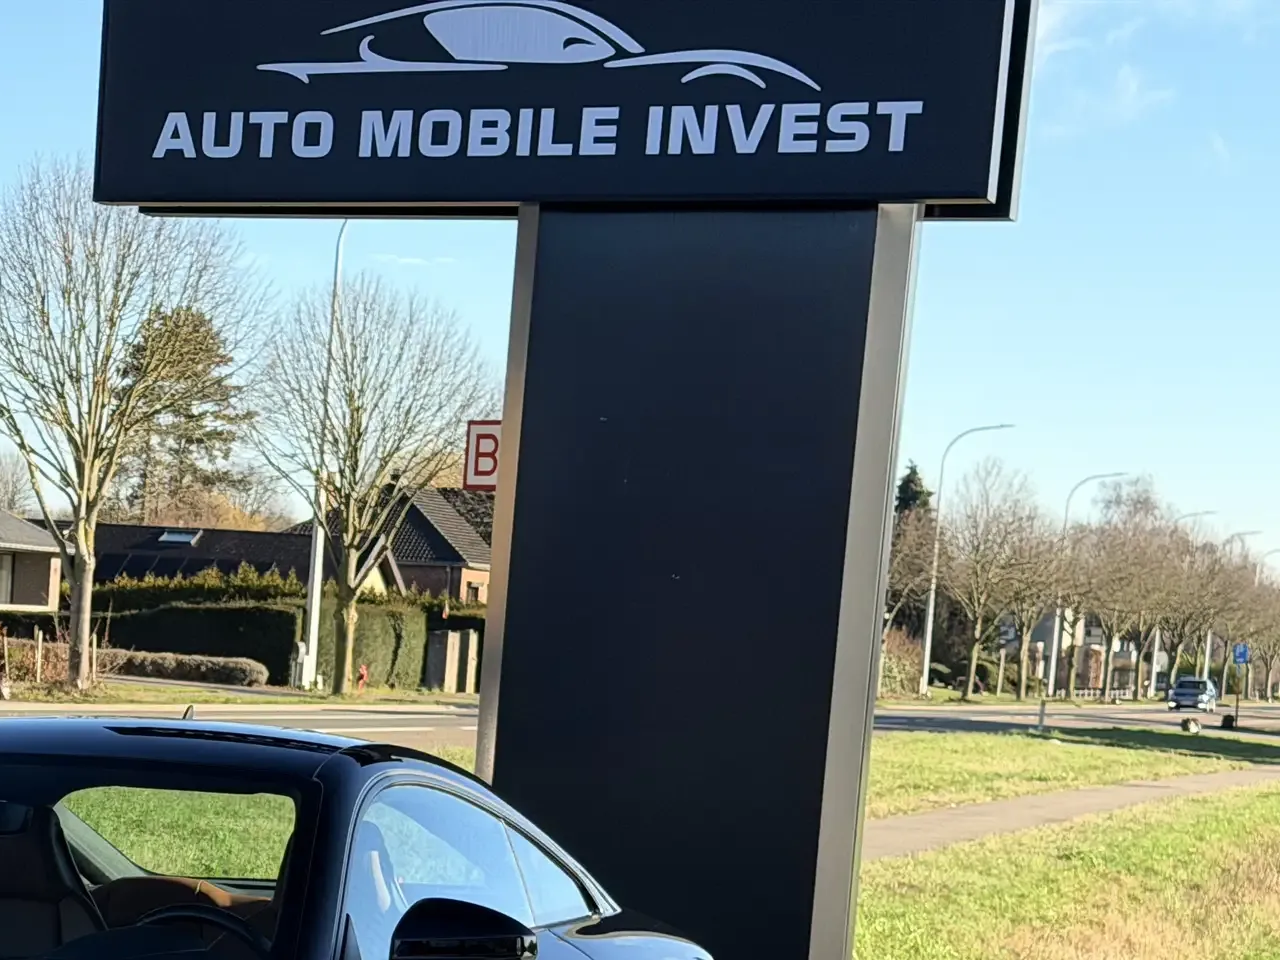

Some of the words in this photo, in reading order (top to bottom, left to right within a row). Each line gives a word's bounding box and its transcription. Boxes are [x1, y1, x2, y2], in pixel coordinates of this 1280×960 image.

[152, 110, 334, 158] AUTO
[358, 106, 620, 157] MOBILE
[645, 101, 924, 154] INVEST
